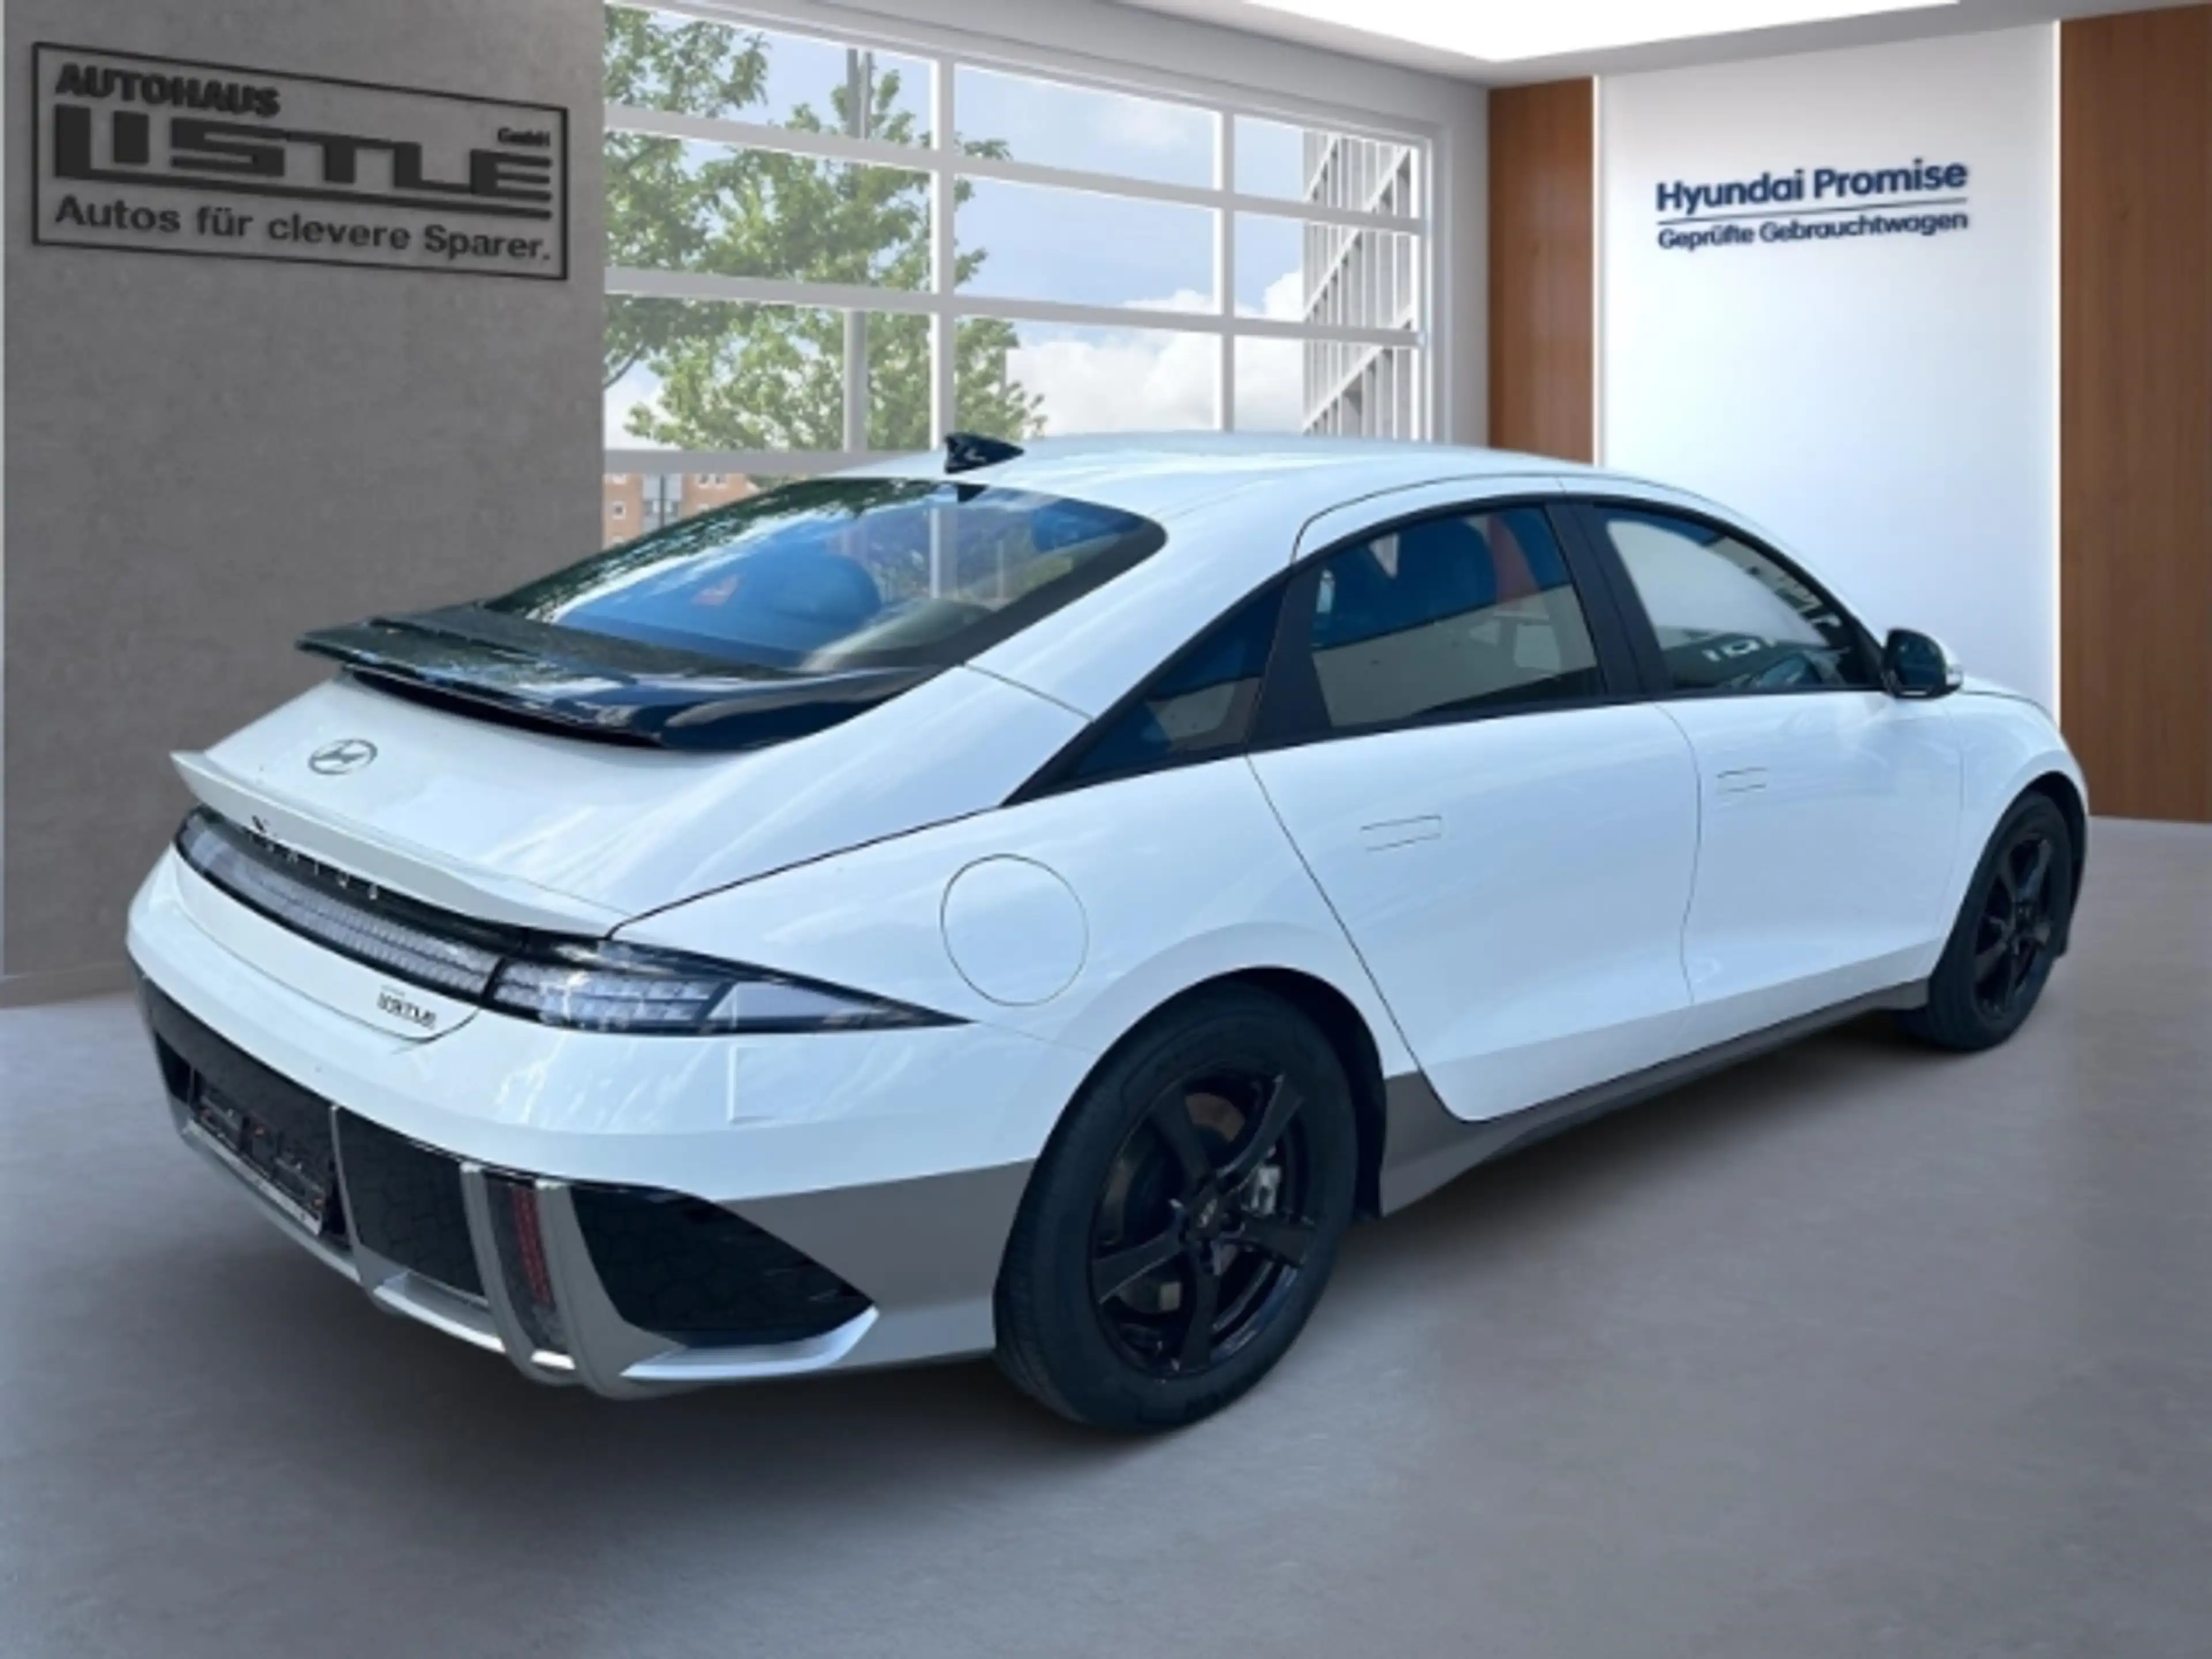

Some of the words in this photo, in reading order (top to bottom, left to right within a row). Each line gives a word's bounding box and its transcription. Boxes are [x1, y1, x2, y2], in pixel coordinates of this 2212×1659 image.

[55, 62, 281, 119] AUTOHAUS
[54, 103, 552, 221] LISTLE
[1657, 168, 1805, 216] Hyundai
[1813, 158, 1969, 199] Promise
[54, 194, 181, 234] Autos
[196, 205, 254, 237] für
[267, 213, 411, 250] clevere
[424, 224, 551, 261] Sparer.
[1658, 224, 1755, 251] Geprüfte
[1759, 211, 1969, 243] Gebrauchtwagen
